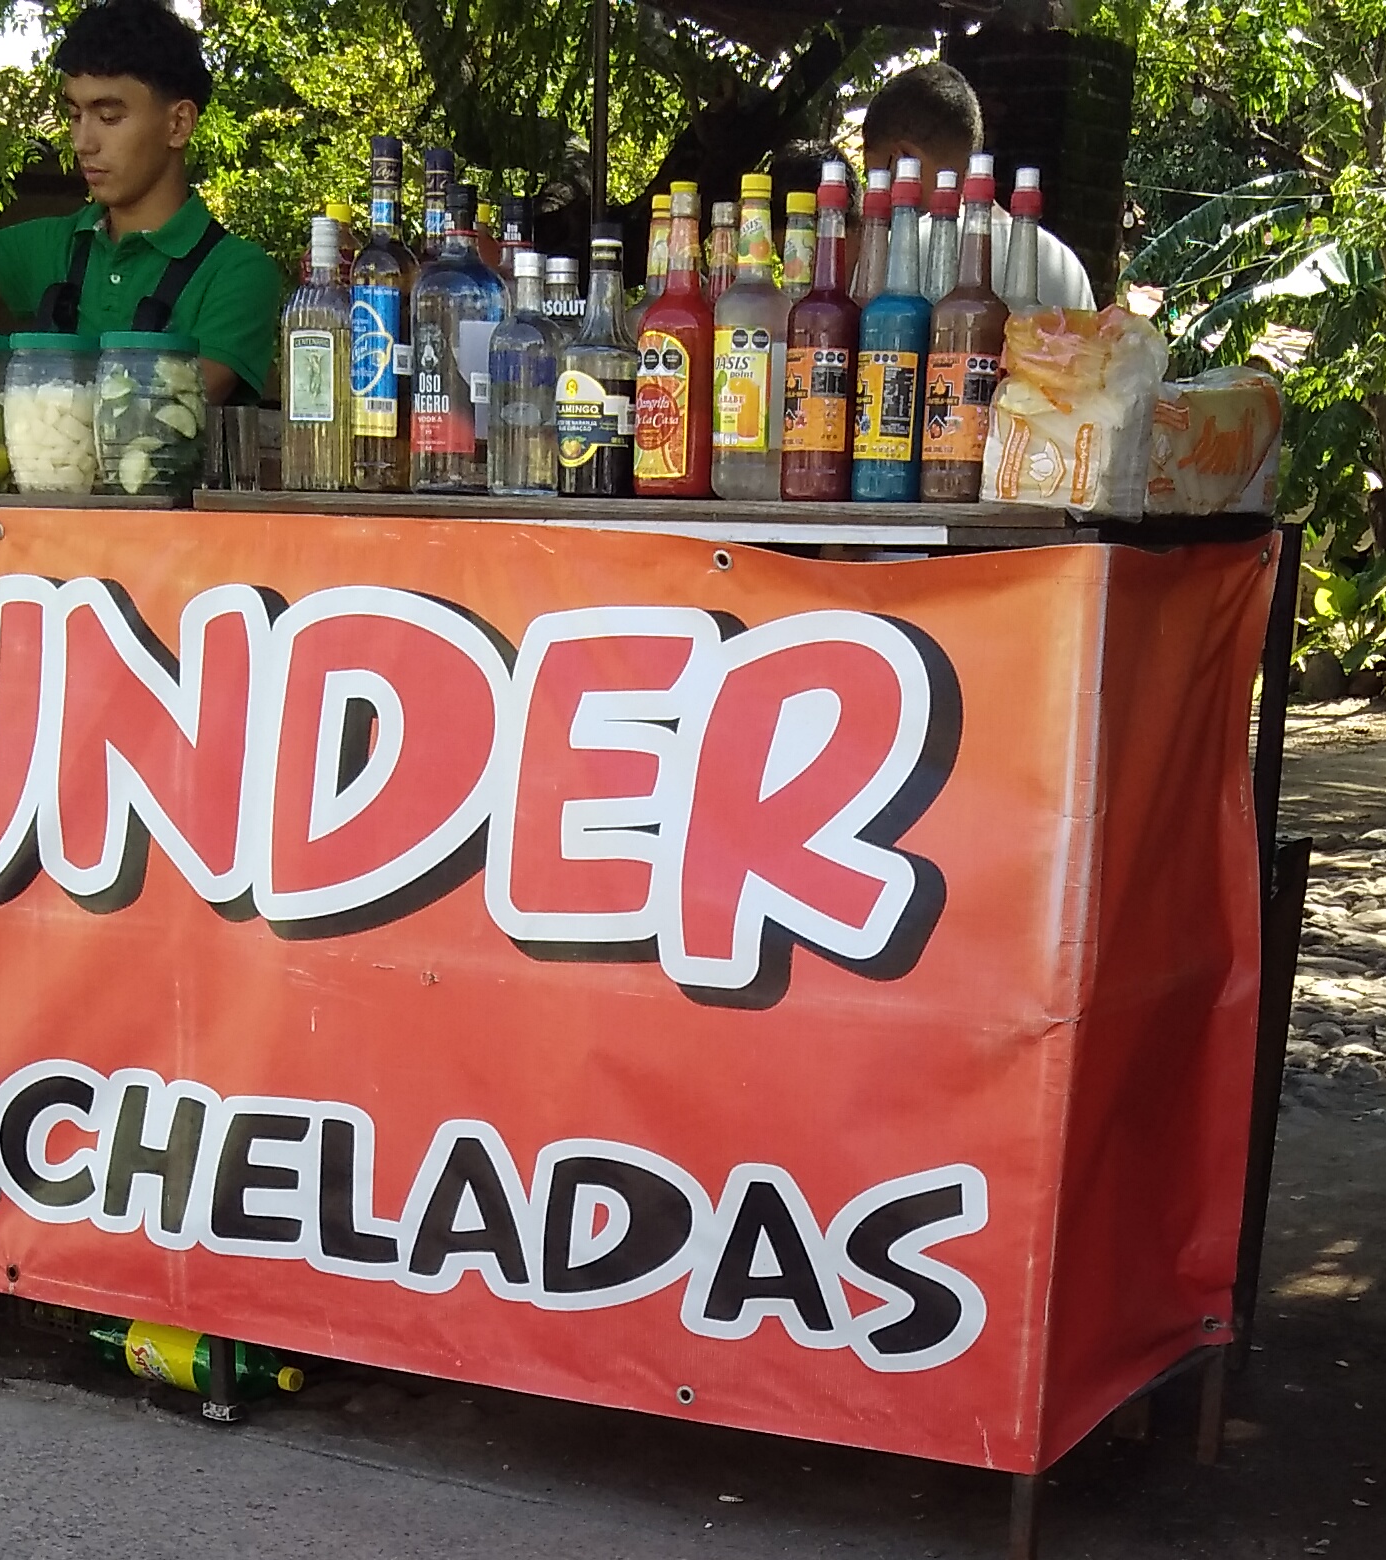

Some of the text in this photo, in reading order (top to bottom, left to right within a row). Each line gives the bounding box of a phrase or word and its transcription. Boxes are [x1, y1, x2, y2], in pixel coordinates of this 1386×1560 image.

[418, 373, 441, 392] OSO
[414, 394, 450, 414] NEGRO
[652, 412, 679, 428] Casa
